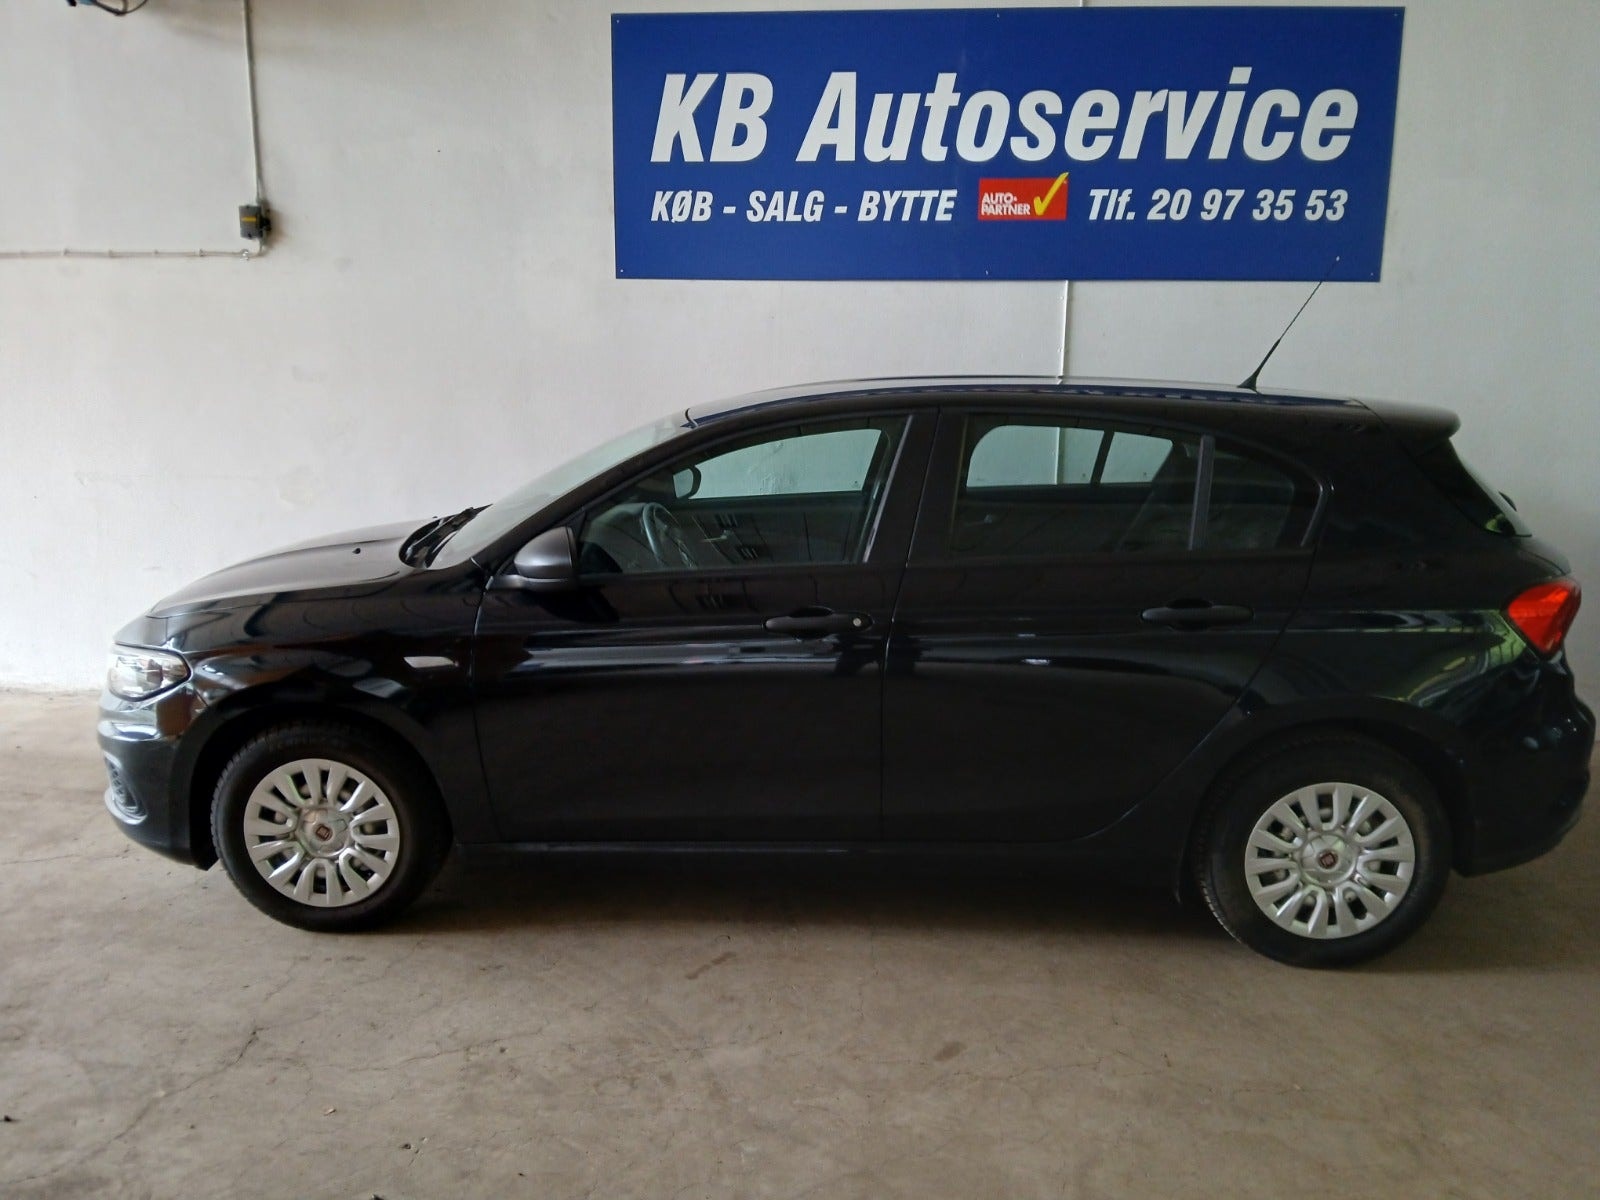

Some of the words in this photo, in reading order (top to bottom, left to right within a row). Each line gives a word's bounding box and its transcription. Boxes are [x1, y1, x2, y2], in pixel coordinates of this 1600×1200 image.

[650, 72, 774, 163] KB
[795, 66, 1359, 163] Autoservice
[650, 189, 714, 224] KØB
[746, 190, 825, 223] SALG
[857, 188, 958, 222] BYTTE
[981, 203, 1031, 216] PARTNER
[1088, 188, 1136, 221] Tlf.
[1146, 188, 1192, 221] 20
[1200, 188, 1245, 221] 97
[1252, 188, 1296, 221] 35
[1304, 189, 1348, 221] 53
